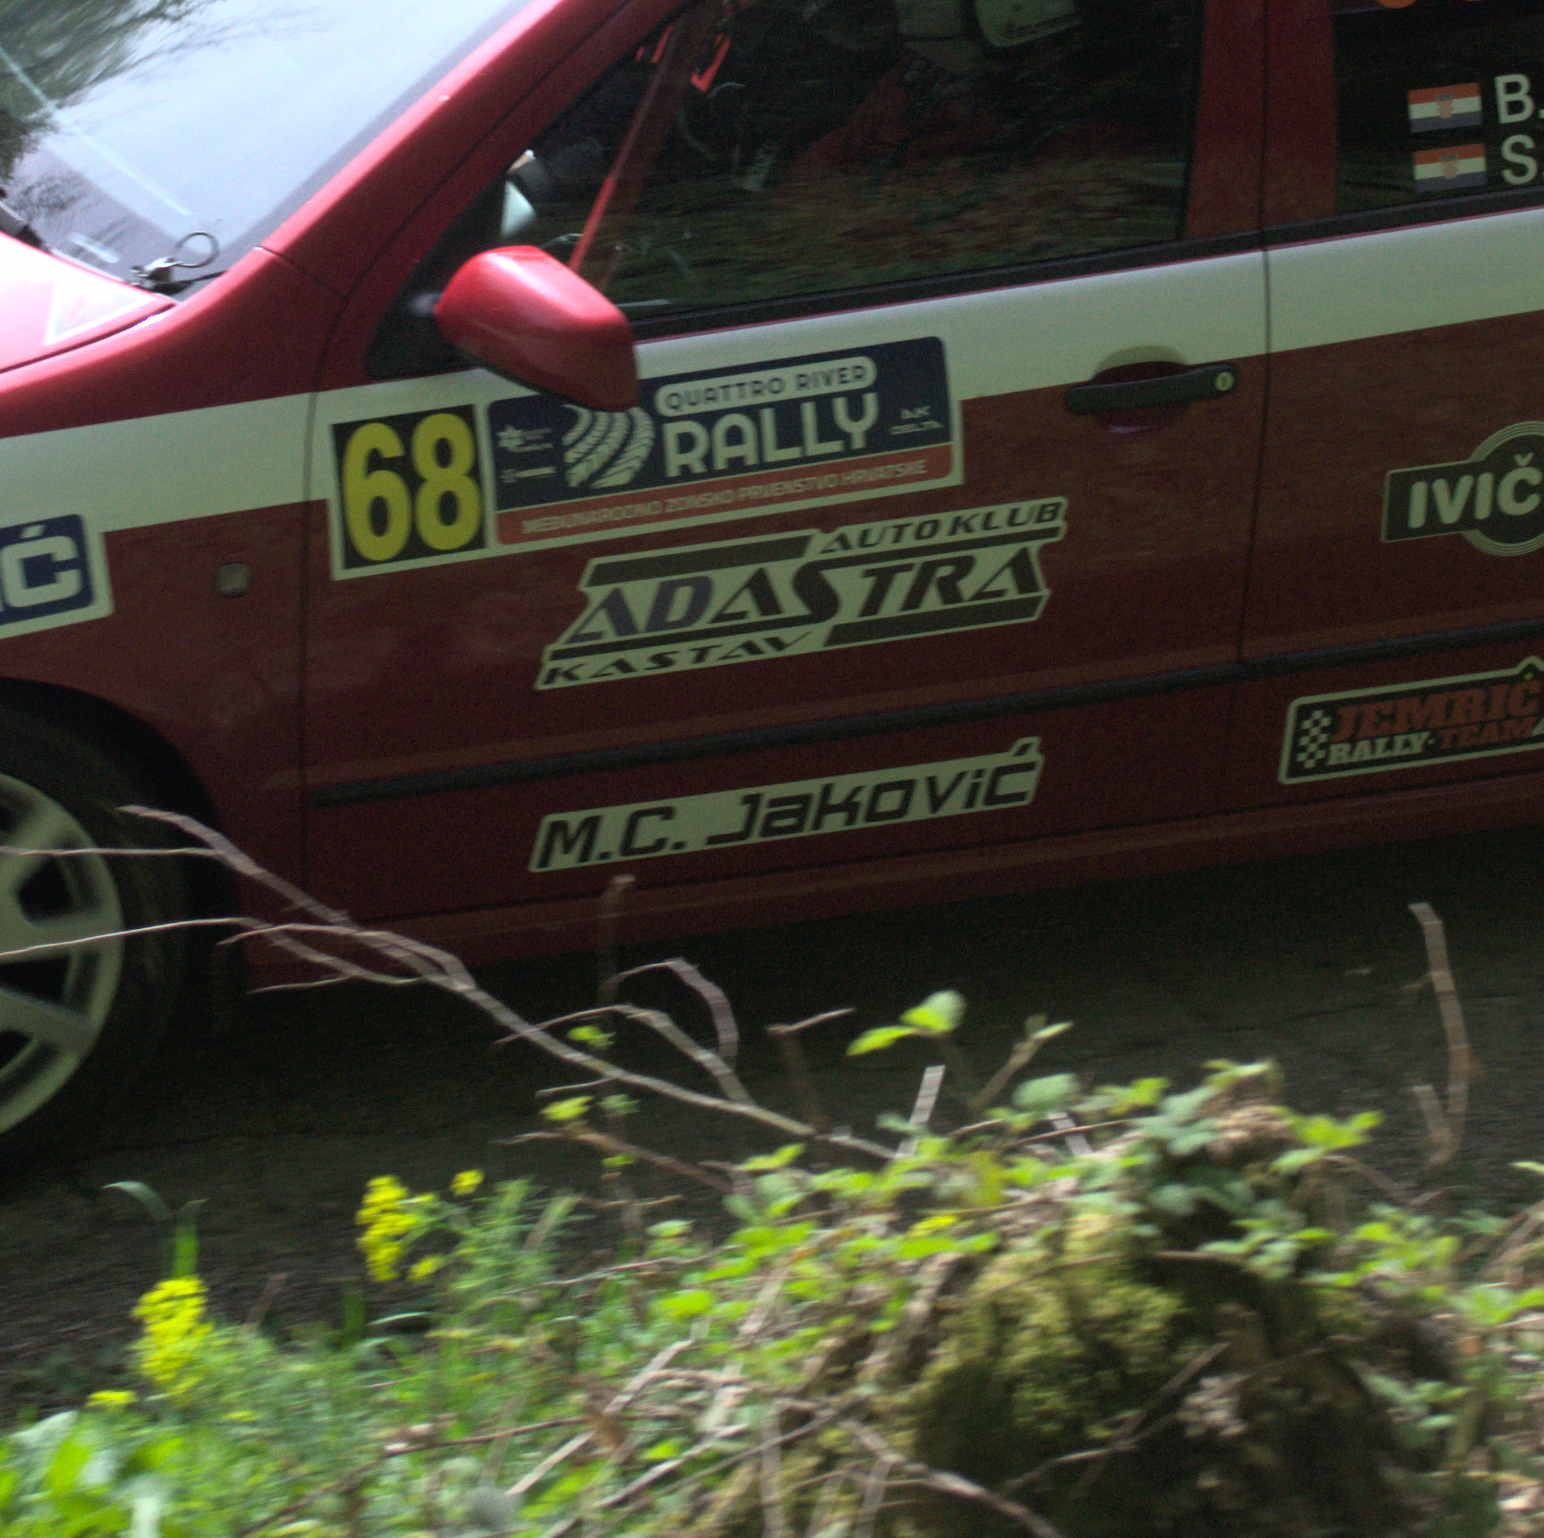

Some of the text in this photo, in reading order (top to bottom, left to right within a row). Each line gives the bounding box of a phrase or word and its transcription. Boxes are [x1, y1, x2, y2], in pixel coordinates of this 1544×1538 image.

[664, 363, 868, 411] QUATTRO RIVER
[662, 392, 879, 478] RALLY
[342, 411, 484, 562] 68
[821, 500, 1063, 555] AUTO KLUB
[562, 545, 1044, 645] ADASTRA
[540, 630, 818, 685] KASTAV
[1325, 716, 1537, 767] RALLY TEAM
[534, 739, 1041, 869] M.C. Jaković
